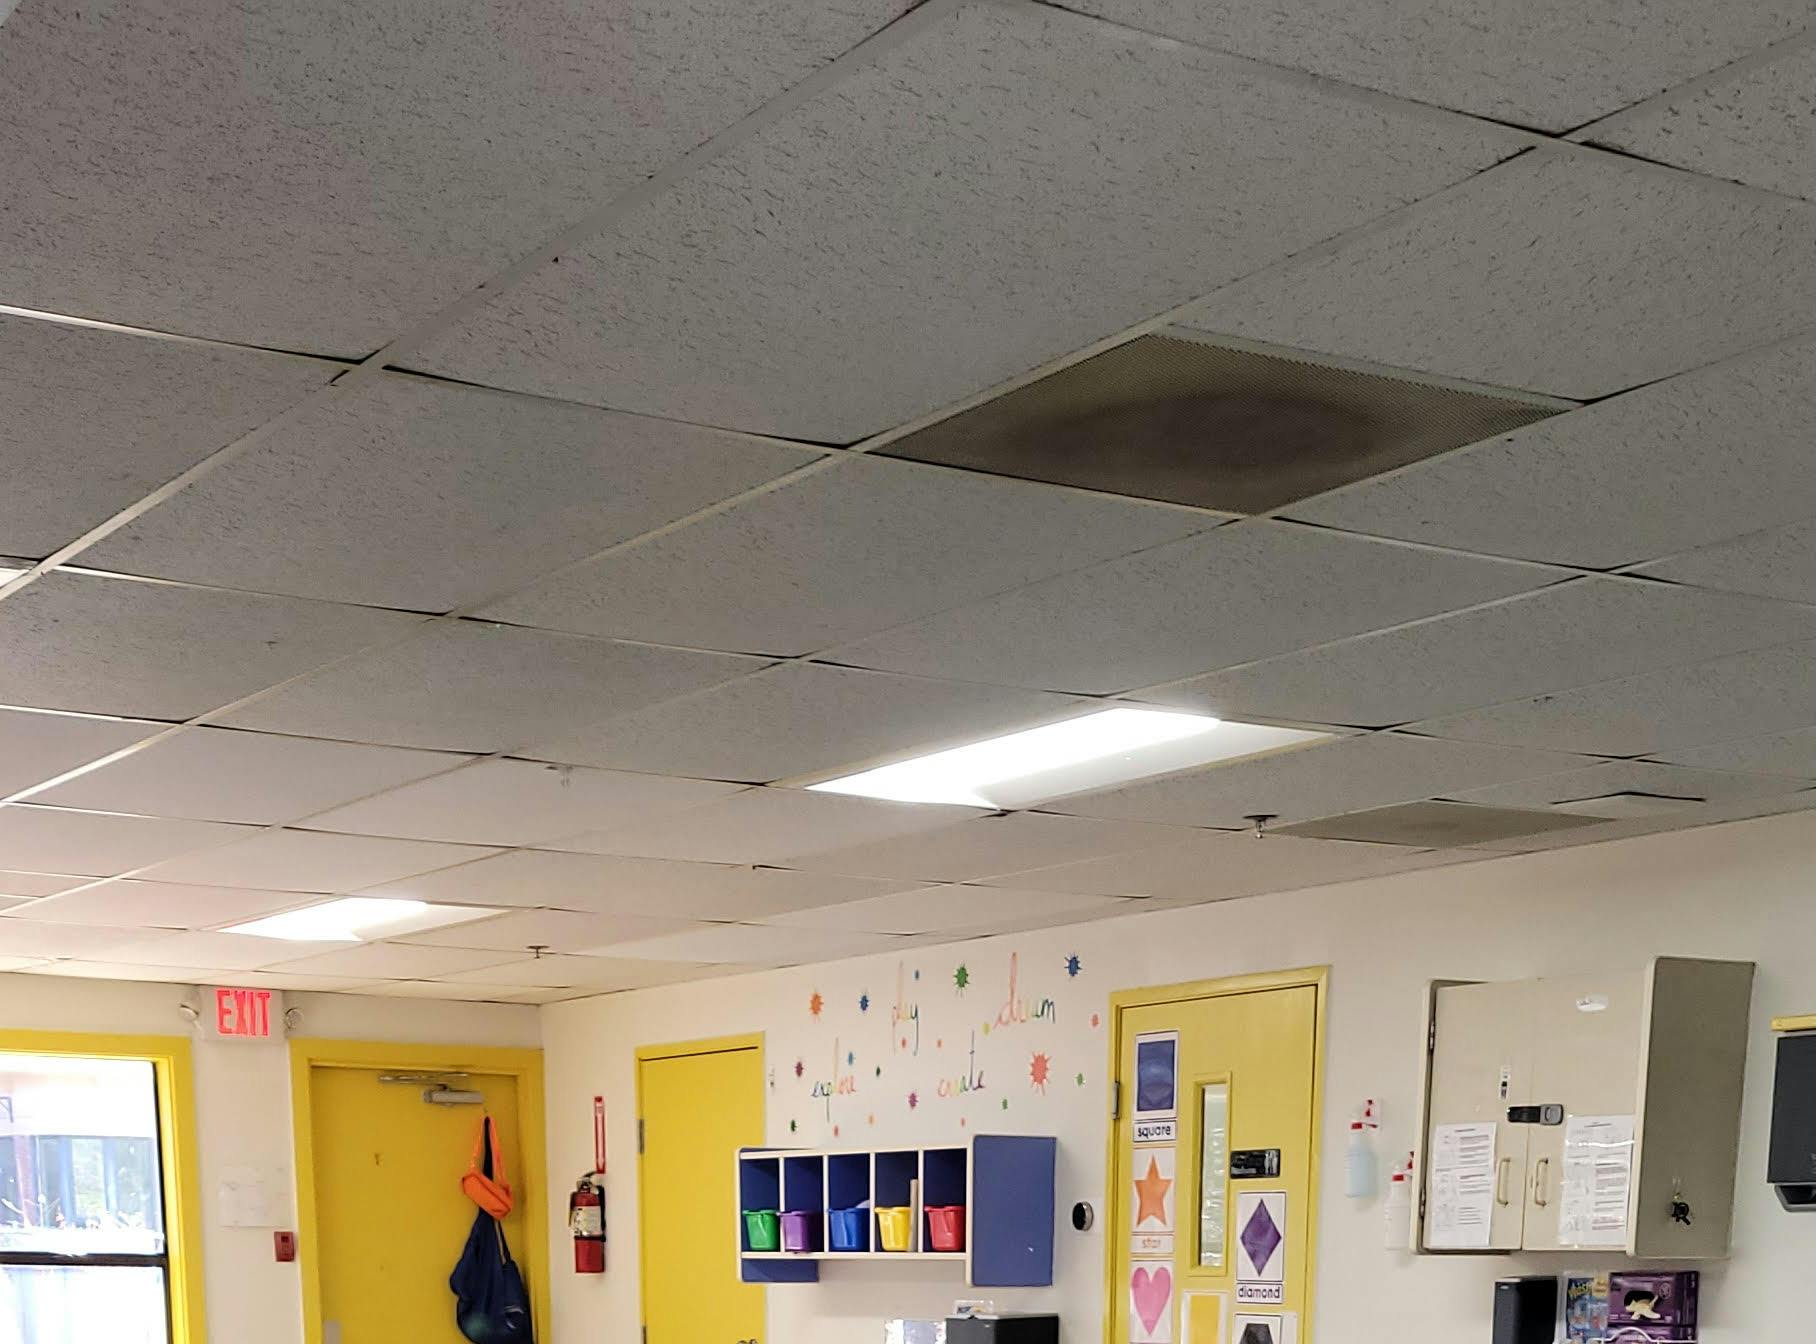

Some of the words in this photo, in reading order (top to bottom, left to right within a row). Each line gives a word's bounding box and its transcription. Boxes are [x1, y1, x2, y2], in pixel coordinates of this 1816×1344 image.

[217, 989, 270, 1036] EXIT
[1137, 1125, 1171, 1139] square
[1238, 1286, 1281, 1299] diamond
